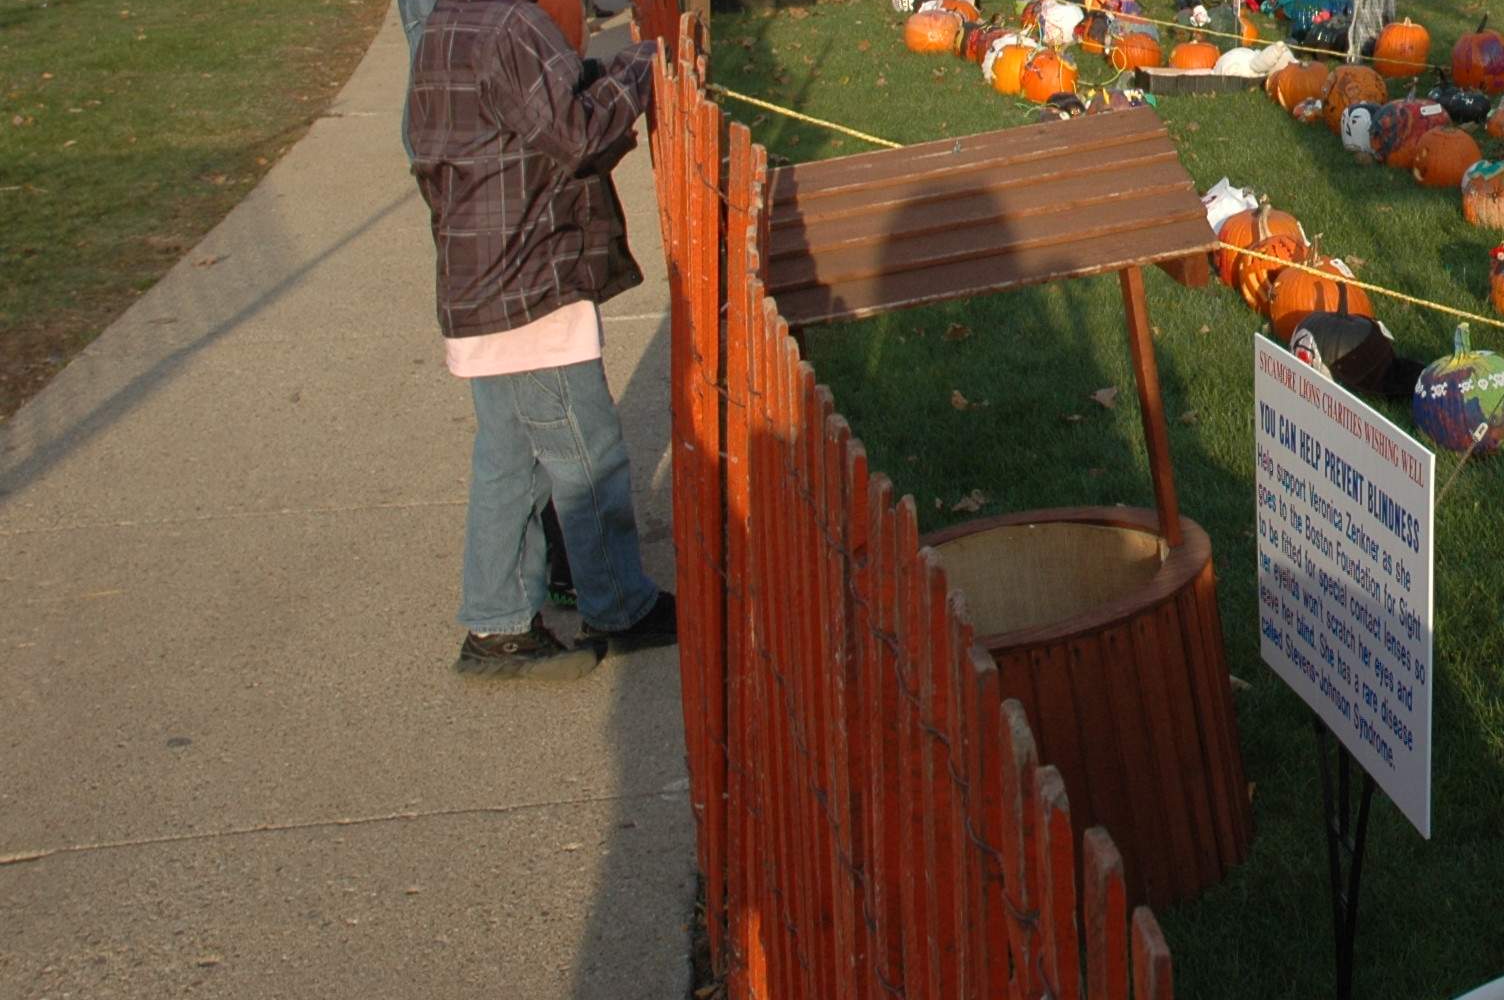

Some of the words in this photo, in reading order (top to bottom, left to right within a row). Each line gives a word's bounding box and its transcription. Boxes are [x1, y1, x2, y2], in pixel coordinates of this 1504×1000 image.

[1260, 351, 1296, 394] SYCAMORE
[1300, 375, 1321, 409] LIONS
[1322, 392, 1362, 440] CHARITIES
[1364, 422, 1399, 467] WISHING
[1401, 450, 1424, 488] WELL
[1260, 400, 1276, 439] YOU
[1279, 414, 1296, 454] CAN
[1300, 429, 1321, 471] HELP
[1325, 448, 1364, 506] PREVENT
[1368, 480, 1420, 553] BLINDNESS
[1257, 443, 1274, 480] Help
[1277, 464, 1306, 502] support
[1308, 482, 1343, 532] Veronica
[1382, 551, 1393, 576] as
[1396, 558, 1411, 592] she
[1258, 483, 1276, 512] goes
[1279, 495, 1288, 521] to
[1290, 504, 1303, 534] the
[1306, 514, 1334, 560] Boston
[1336, 540, 1380, 604] Foundation
[1384, 583, 1396, 616] for
[1399, 597, 1421, 642] Sight
[1258, 512, 1267, 537] to
[1269, 518, 1279, 548] be
[1281, 530, 1301, 568] fitted
[1305, 550, 1316, 578] for
[1319, 568, 1347, 611] special
[1350, 597, 1381, 641] contact
[1384, 622, 1411, 671] lenses
[1414, 659, 1426, 685] so
[1260, 577, 1279, 614] leave
[1282, 595, 1294, 626] her
[1296, 615, 1316, 649] blind.
[1319, 632, 1335, 668] She
[1337, 650, 1351, 685] has
[1354, 673, 1360, 694] a
[1362, 682, 1378, 713] rare
[1381, 695, 1413, 751] disease
[1303, 590, 1324, 624] won't
[1326, 610, 1355, 654] scratch
[1358, 634, 1372, 667] her
[1375, 656, 1394, 692] eyes
[1397, 678, 1413, 712] and
[1261, 615, 1284, 650] called
[1286, 633, 1351, 721] Stevens-Johnson
[1354, 703, 1396, 770] Syndrome.
